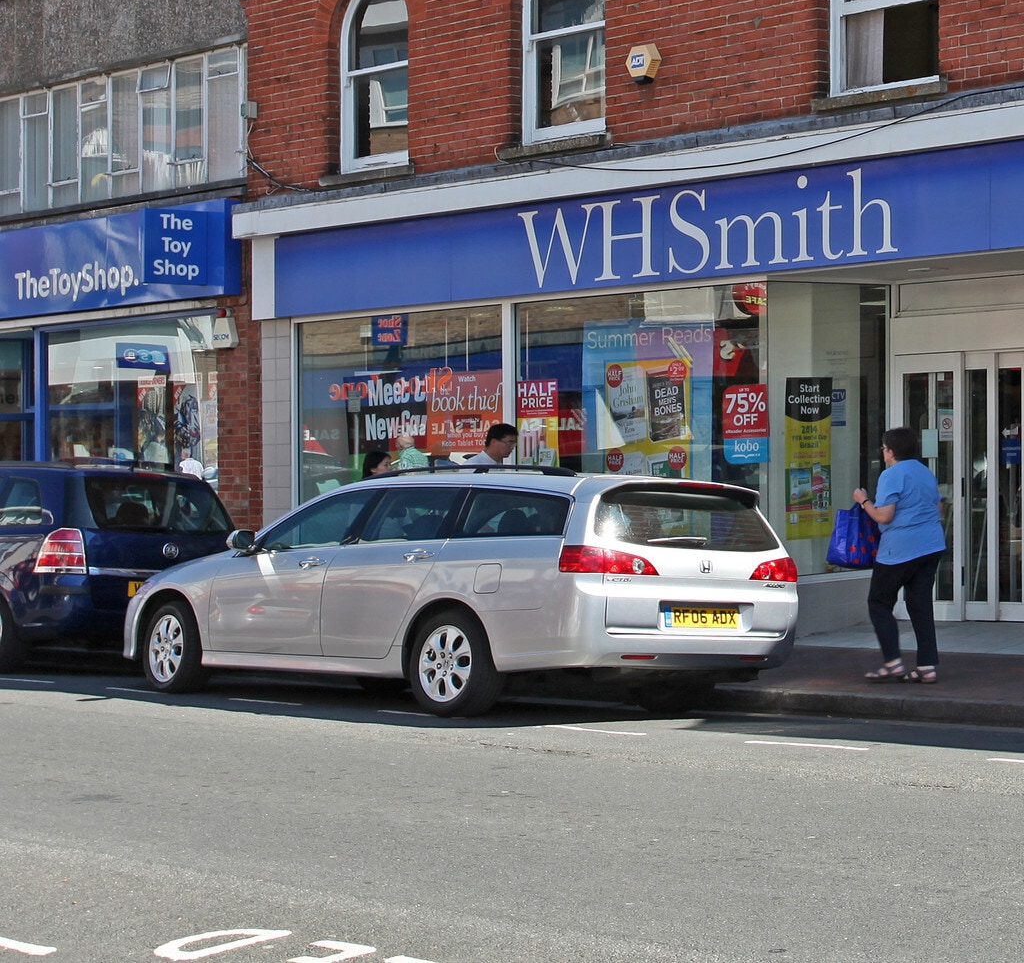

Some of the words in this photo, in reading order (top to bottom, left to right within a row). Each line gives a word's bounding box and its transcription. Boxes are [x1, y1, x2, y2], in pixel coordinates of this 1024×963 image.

[160, 213, 193, 231] The
[517, 167, 899, 289] WHSmith
[161, 237, 192, 258] Toy
[153, 259, 199, 280] Shop
[14, 261, 139, 302] TheToyShop.
[587, 331, 655, 349] Summer
[662, 324, 711, 344] Reads
[457, 375, 476, 383] Watch
[368, 377, 409, 406] Meet
[517, 382, 556, 397] HALF
[619, 384, 637, 397] John
[655, 386, 679, 399] DEAD
[800, 384, 820, 393] Start
[431, 386, 465, 412] book
[467, 383, 503, 413] thief
[521, 397, 553, 408] PRICE
[613, 395, 644, 408] Grisham
[788, 395, 831, 405] Collecting
[832, 392, 845, 400] CTV
[655, 403, 683, 416] BONES
[725, 392, 766, 414] 75%
[800, 406, 820, 414] Now
[733, 413, 758, 426] OFF
[365, 414, 399, 441] New
[457, 439, 474, 447] Tablet
[734, 439, 759, 452] kobo
[673, 609, 708, 624] RF06
[712, 610, 736, 625] ADX
